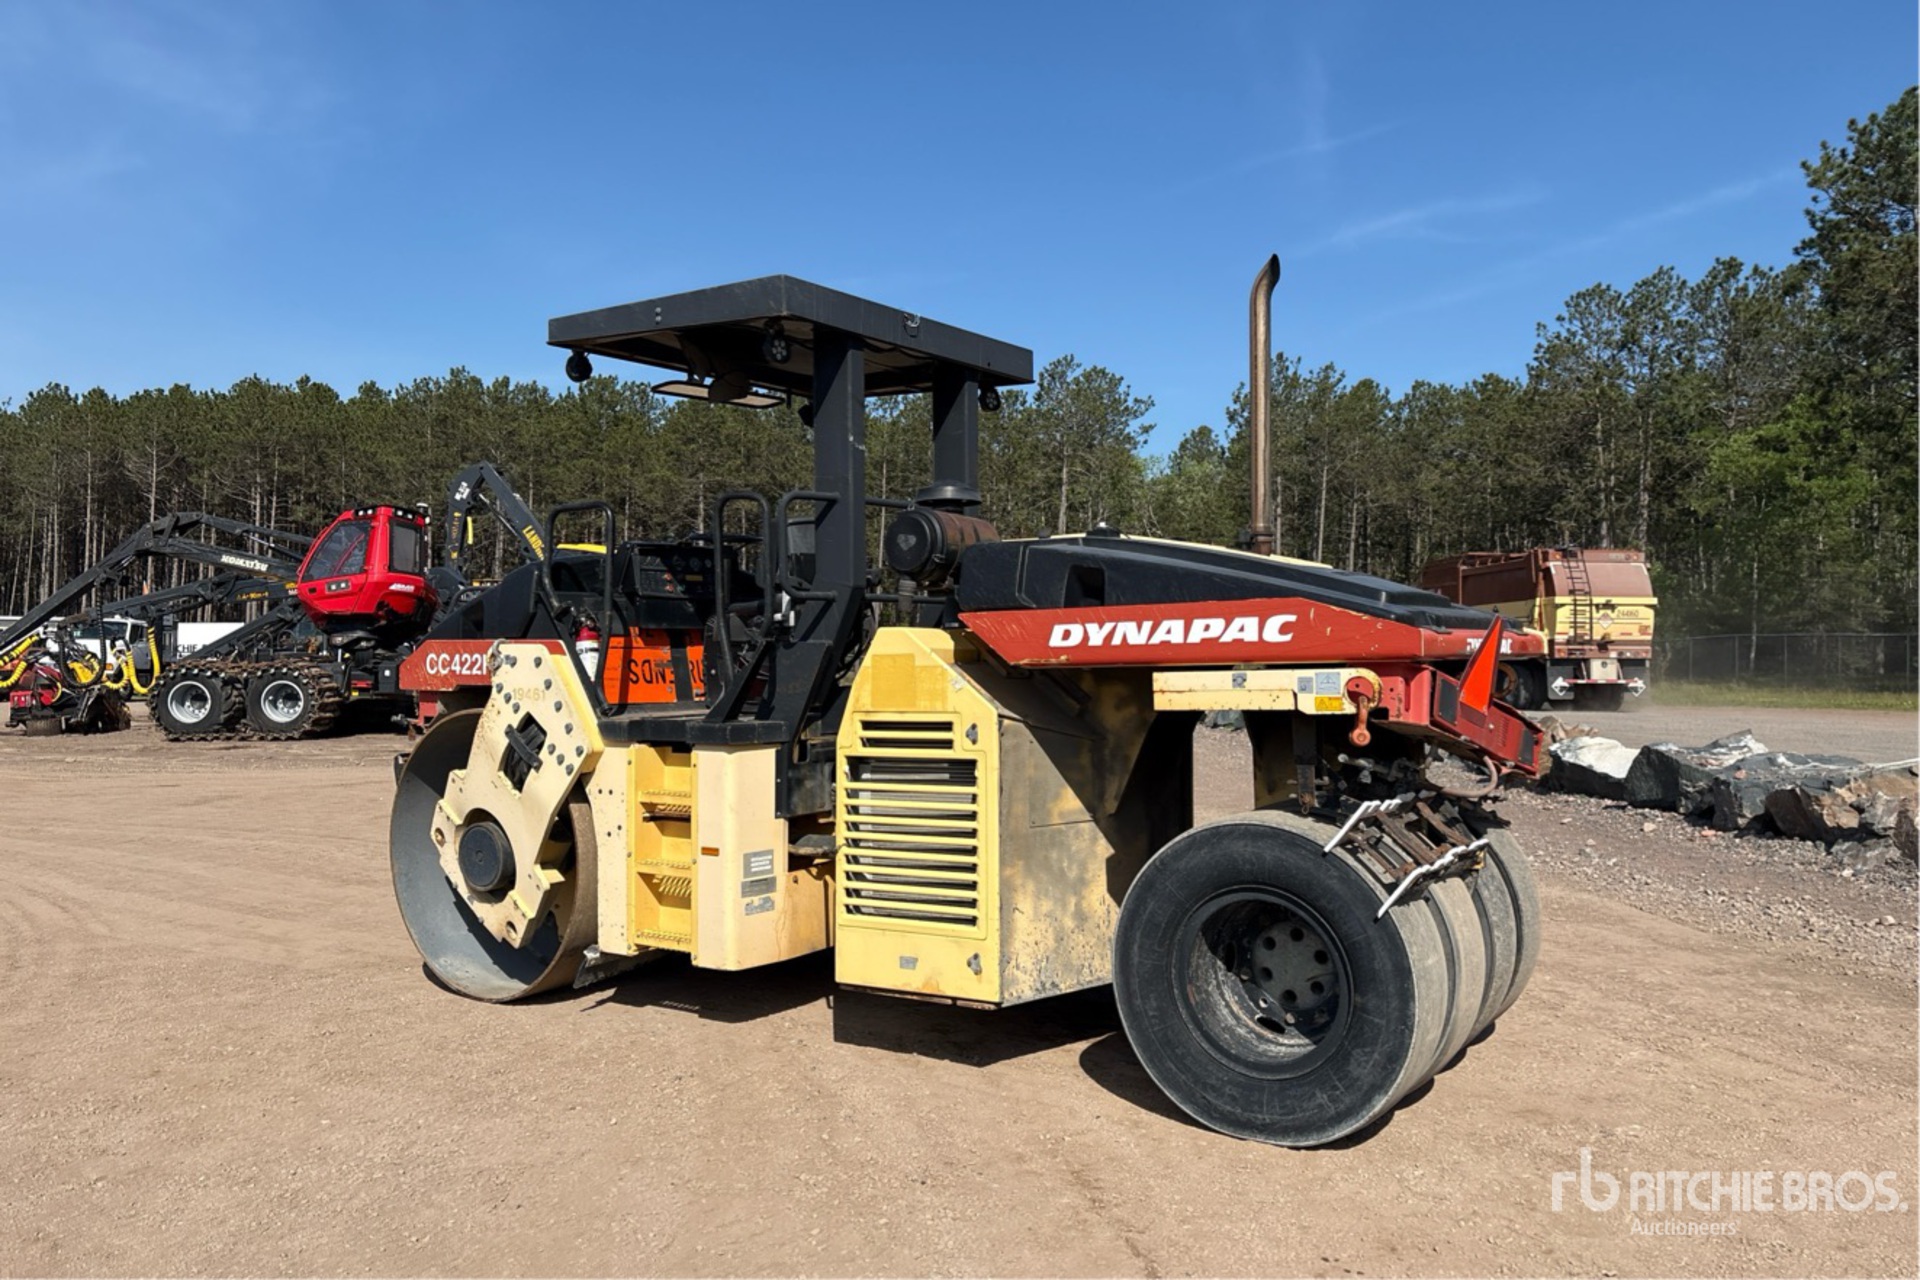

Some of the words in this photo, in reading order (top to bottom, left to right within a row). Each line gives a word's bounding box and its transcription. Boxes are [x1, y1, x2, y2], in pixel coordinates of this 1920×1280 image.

[221, 555, 268, 571] KOMATSU
[1048, 615, 1297, 648] DYNAPAC
[512, 688, 546, 701] 19461
